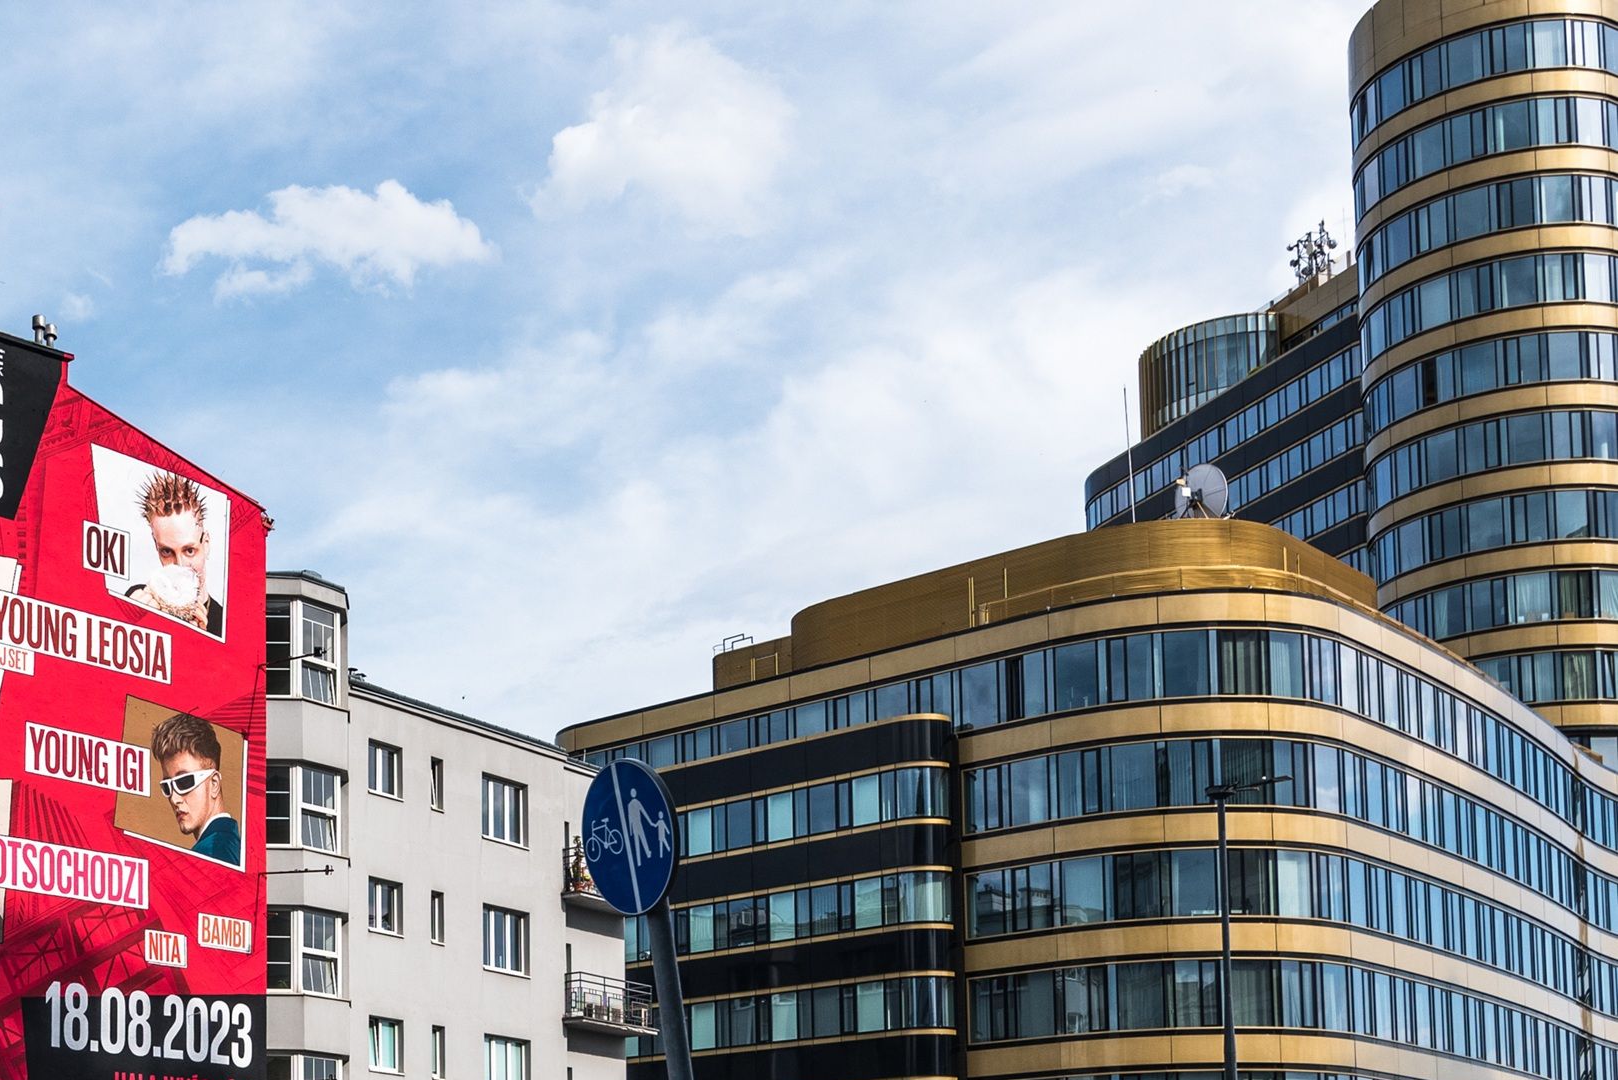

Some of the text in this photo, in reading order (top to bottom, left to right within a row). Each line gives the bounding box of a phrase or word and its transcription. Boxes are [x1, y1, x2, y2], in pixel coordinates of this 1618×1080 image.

[86, 525, 126, 576] OKI
[7, 648, 29, 671] SET
[85, 617, 169, 681] LEOSIA
[29, 726, 144, 793] YOUNG IGI
[148, 931, 182, 963] NITA
[201, 915, 246, 949] BAMBI
[45, 980, 253, 1069] 18.08.2023
